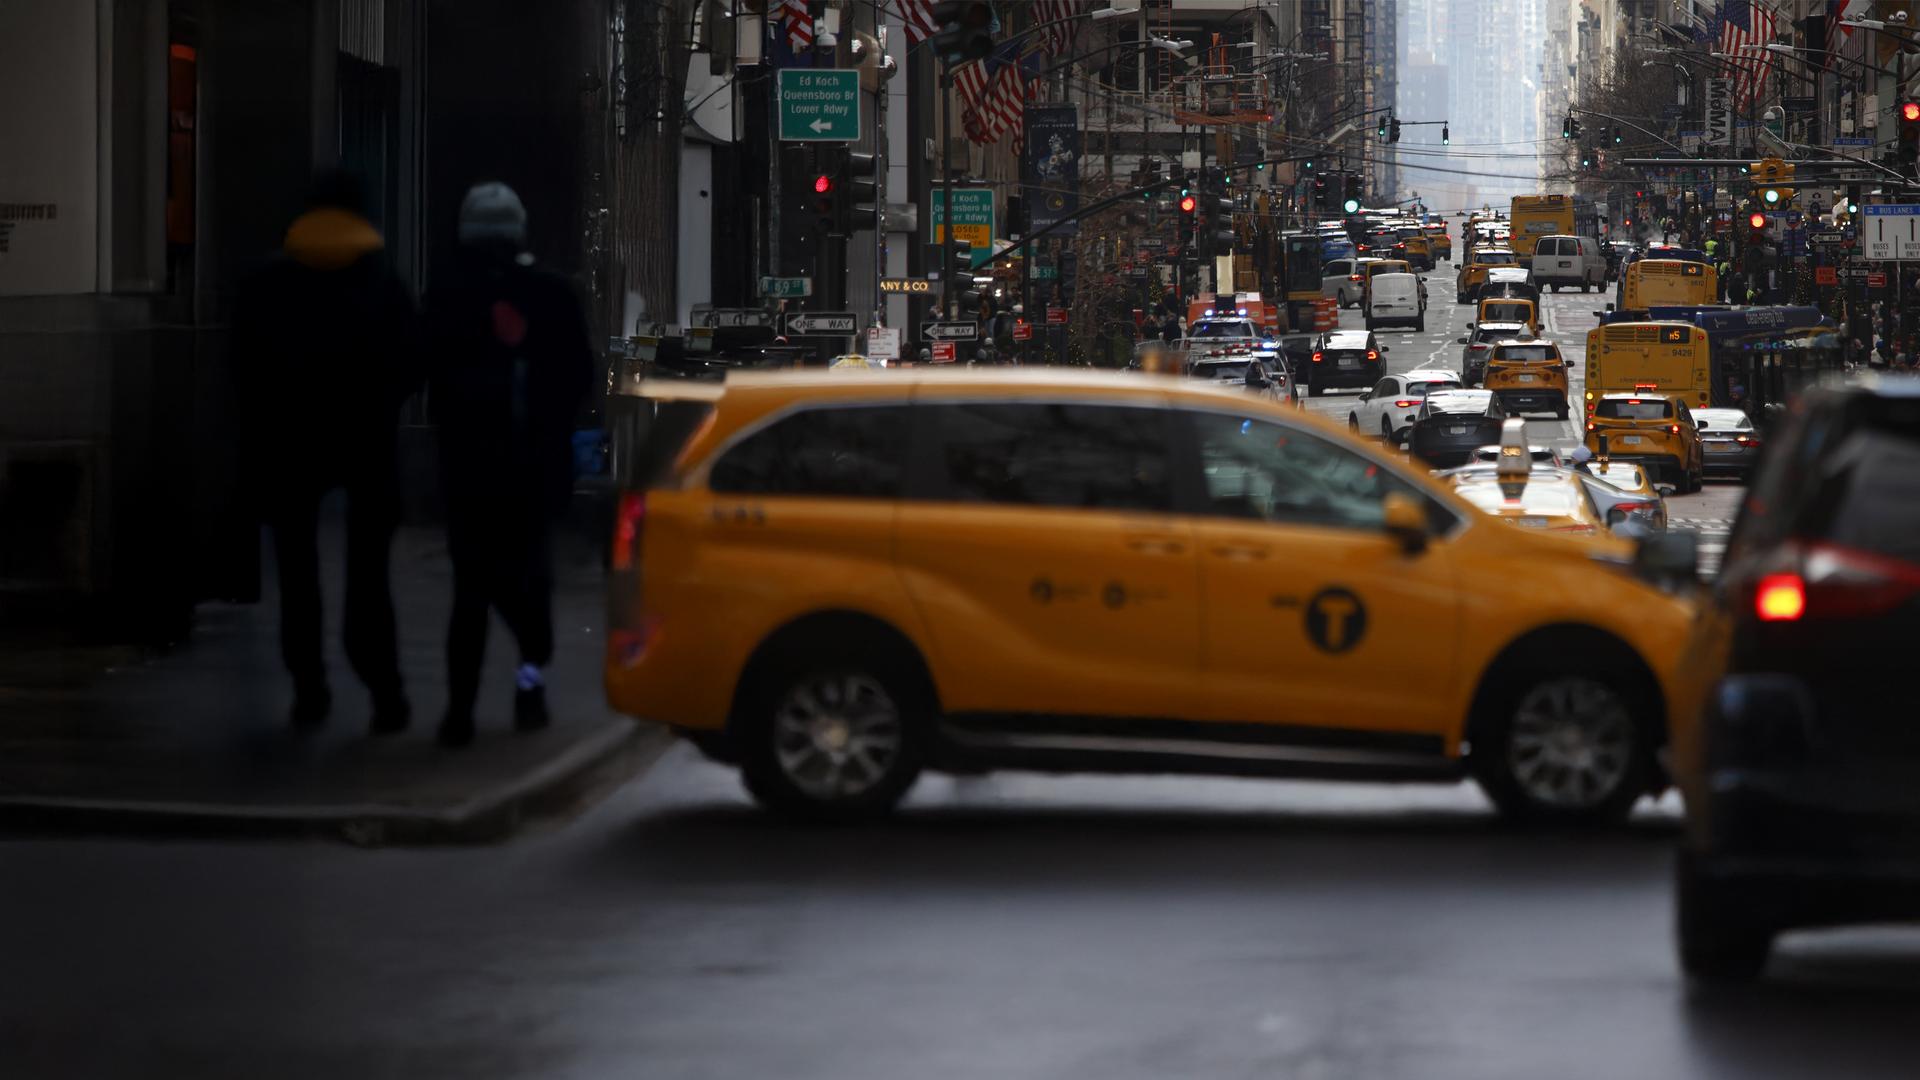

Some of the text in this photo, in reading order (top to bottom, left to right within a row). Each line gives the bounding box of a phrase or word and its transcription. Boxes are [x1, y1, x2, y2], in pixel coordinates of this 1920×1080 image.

[800, 76, 839, 86] Ed Koch
[783, 90, 855, 101] Queensboro Br
[790, 104, 849, 117] Lower Rdwy
[1710, 80, 1727, 142] MoMA
[959, 195, 979, 204] Koch
[1879, 207, 1914, 215] BUS LANES
[964, 214, 989, 223] Rdwy
[951, 226, 980, 234] LOSED
[1872, 242, 1890, 250] BUSES
[880, 281, 900, 291] ANY
[903, 281, 910, 291] &
[795, 320, 851, 329] ONE WAY
[931, 327, 972, 336] ONE WAY
[1318, 597, 1356, 649] T
